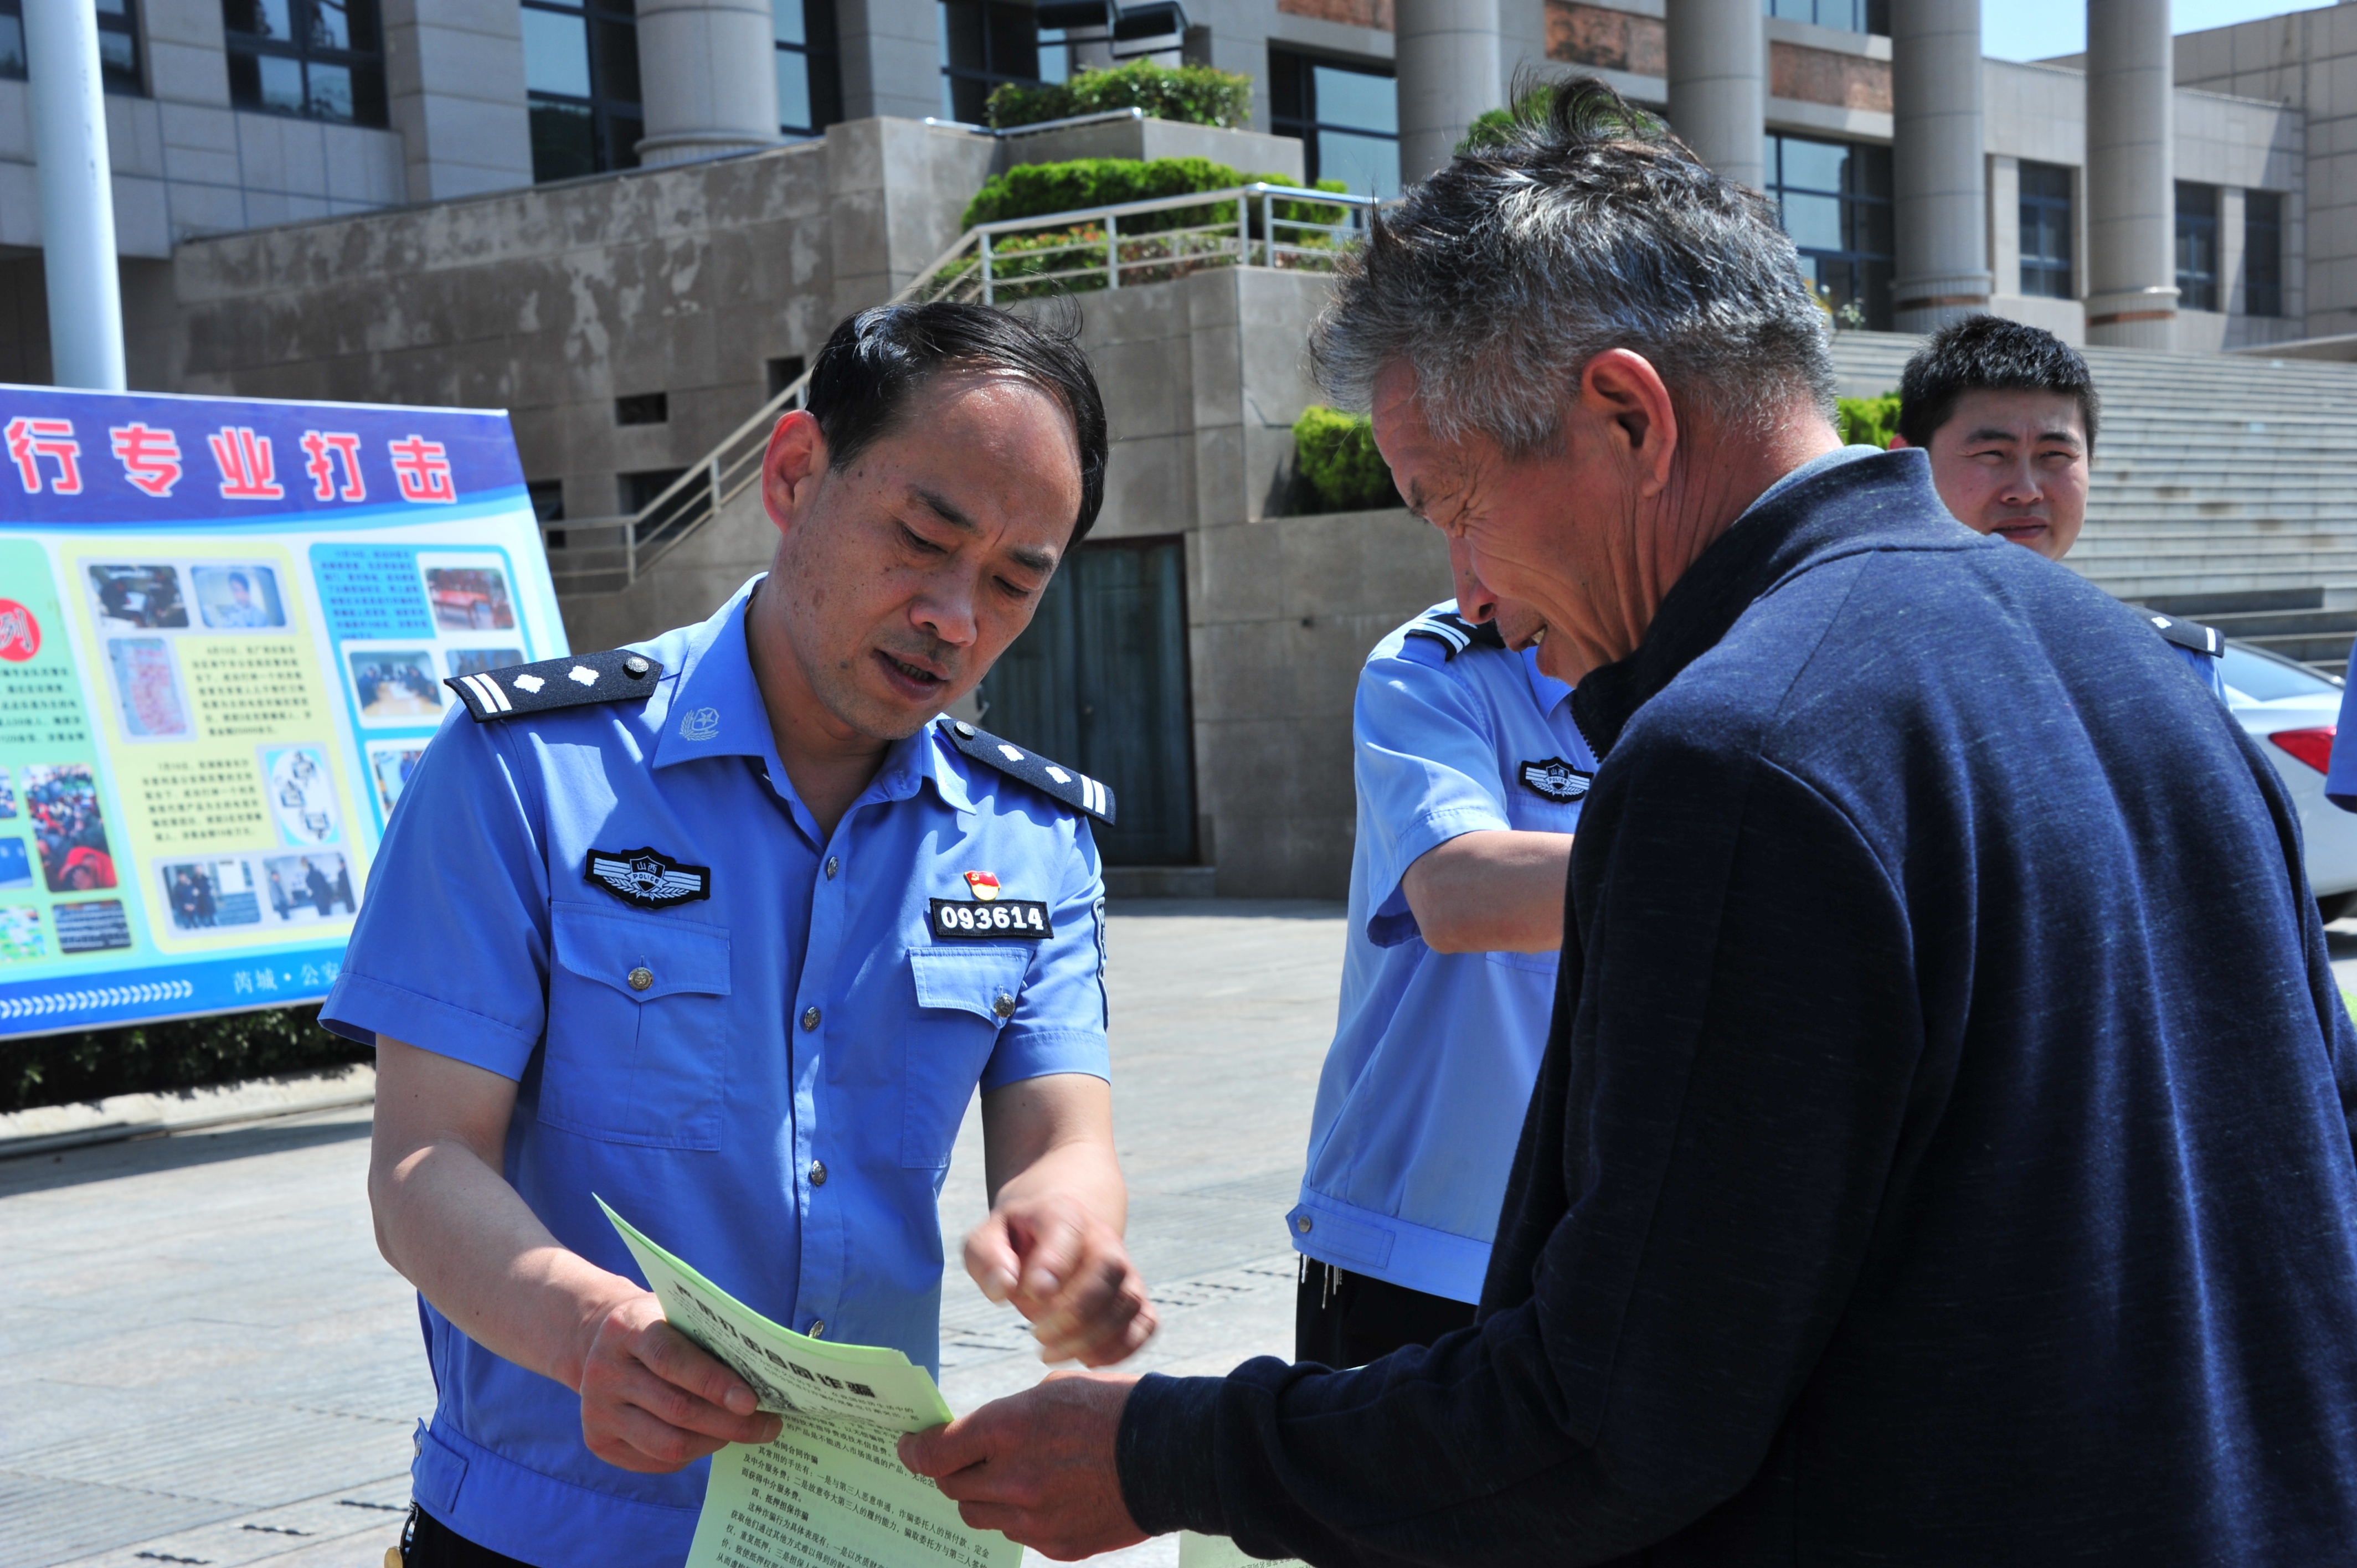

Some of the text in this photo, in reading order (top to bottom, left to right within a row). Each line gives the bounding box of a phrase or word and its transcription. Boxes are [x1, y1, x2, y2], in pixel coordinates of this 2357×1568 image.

[4, 416, 456, 504] 行专业打击
[1551, 768, 1565, 777] 山西
[632, 873, 660, 884] POLICE
[636, 861, 658, 874] 山西
[941, 906, 1044, 931] 093614
[741, 1467, 802, 1503] 而获得中介服务费。
[752, 1487, 809, 1522] 四、抵押担保诈骗
